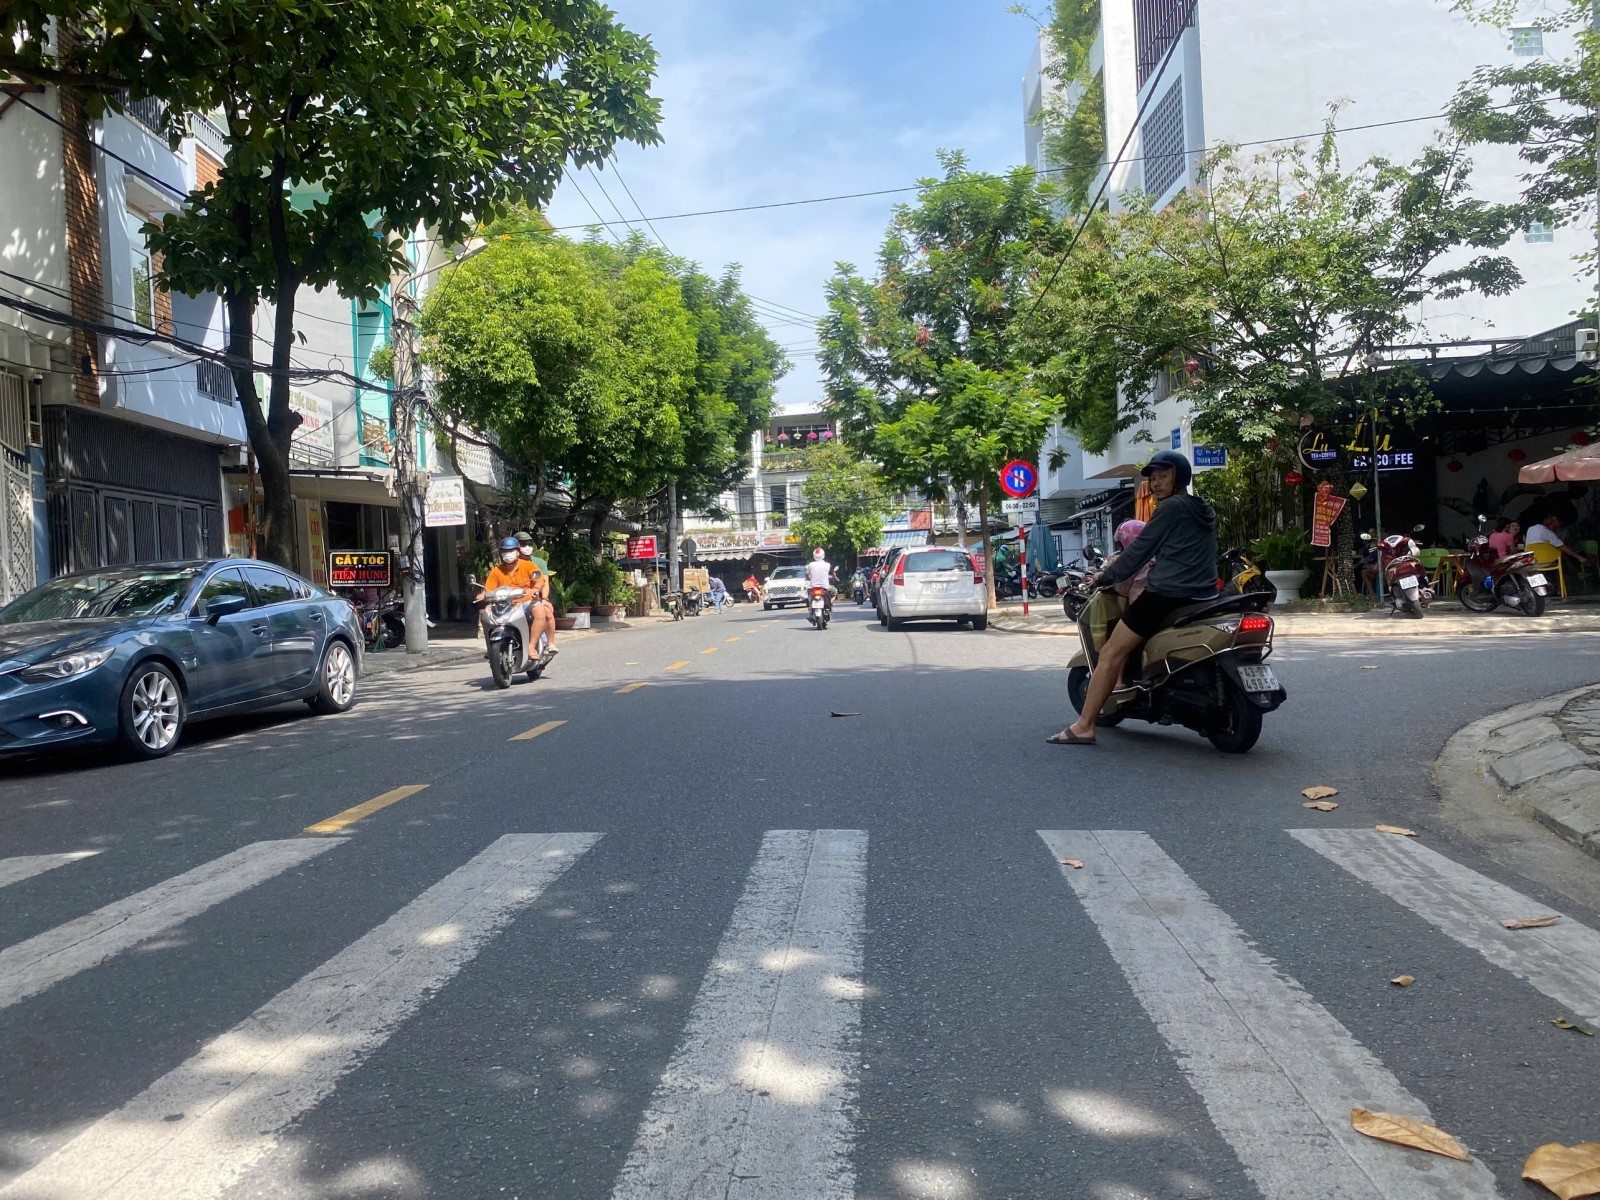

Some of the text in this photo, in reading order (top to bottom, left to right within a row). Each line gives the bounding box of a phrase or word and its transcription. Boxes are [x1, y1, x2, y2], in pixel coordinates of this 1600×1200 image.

[1303, 433, 1329, 454] Lu
[361, 555, 385, 565] TÓC
[332, 567, 388, 580] TIẾN HÙNG
